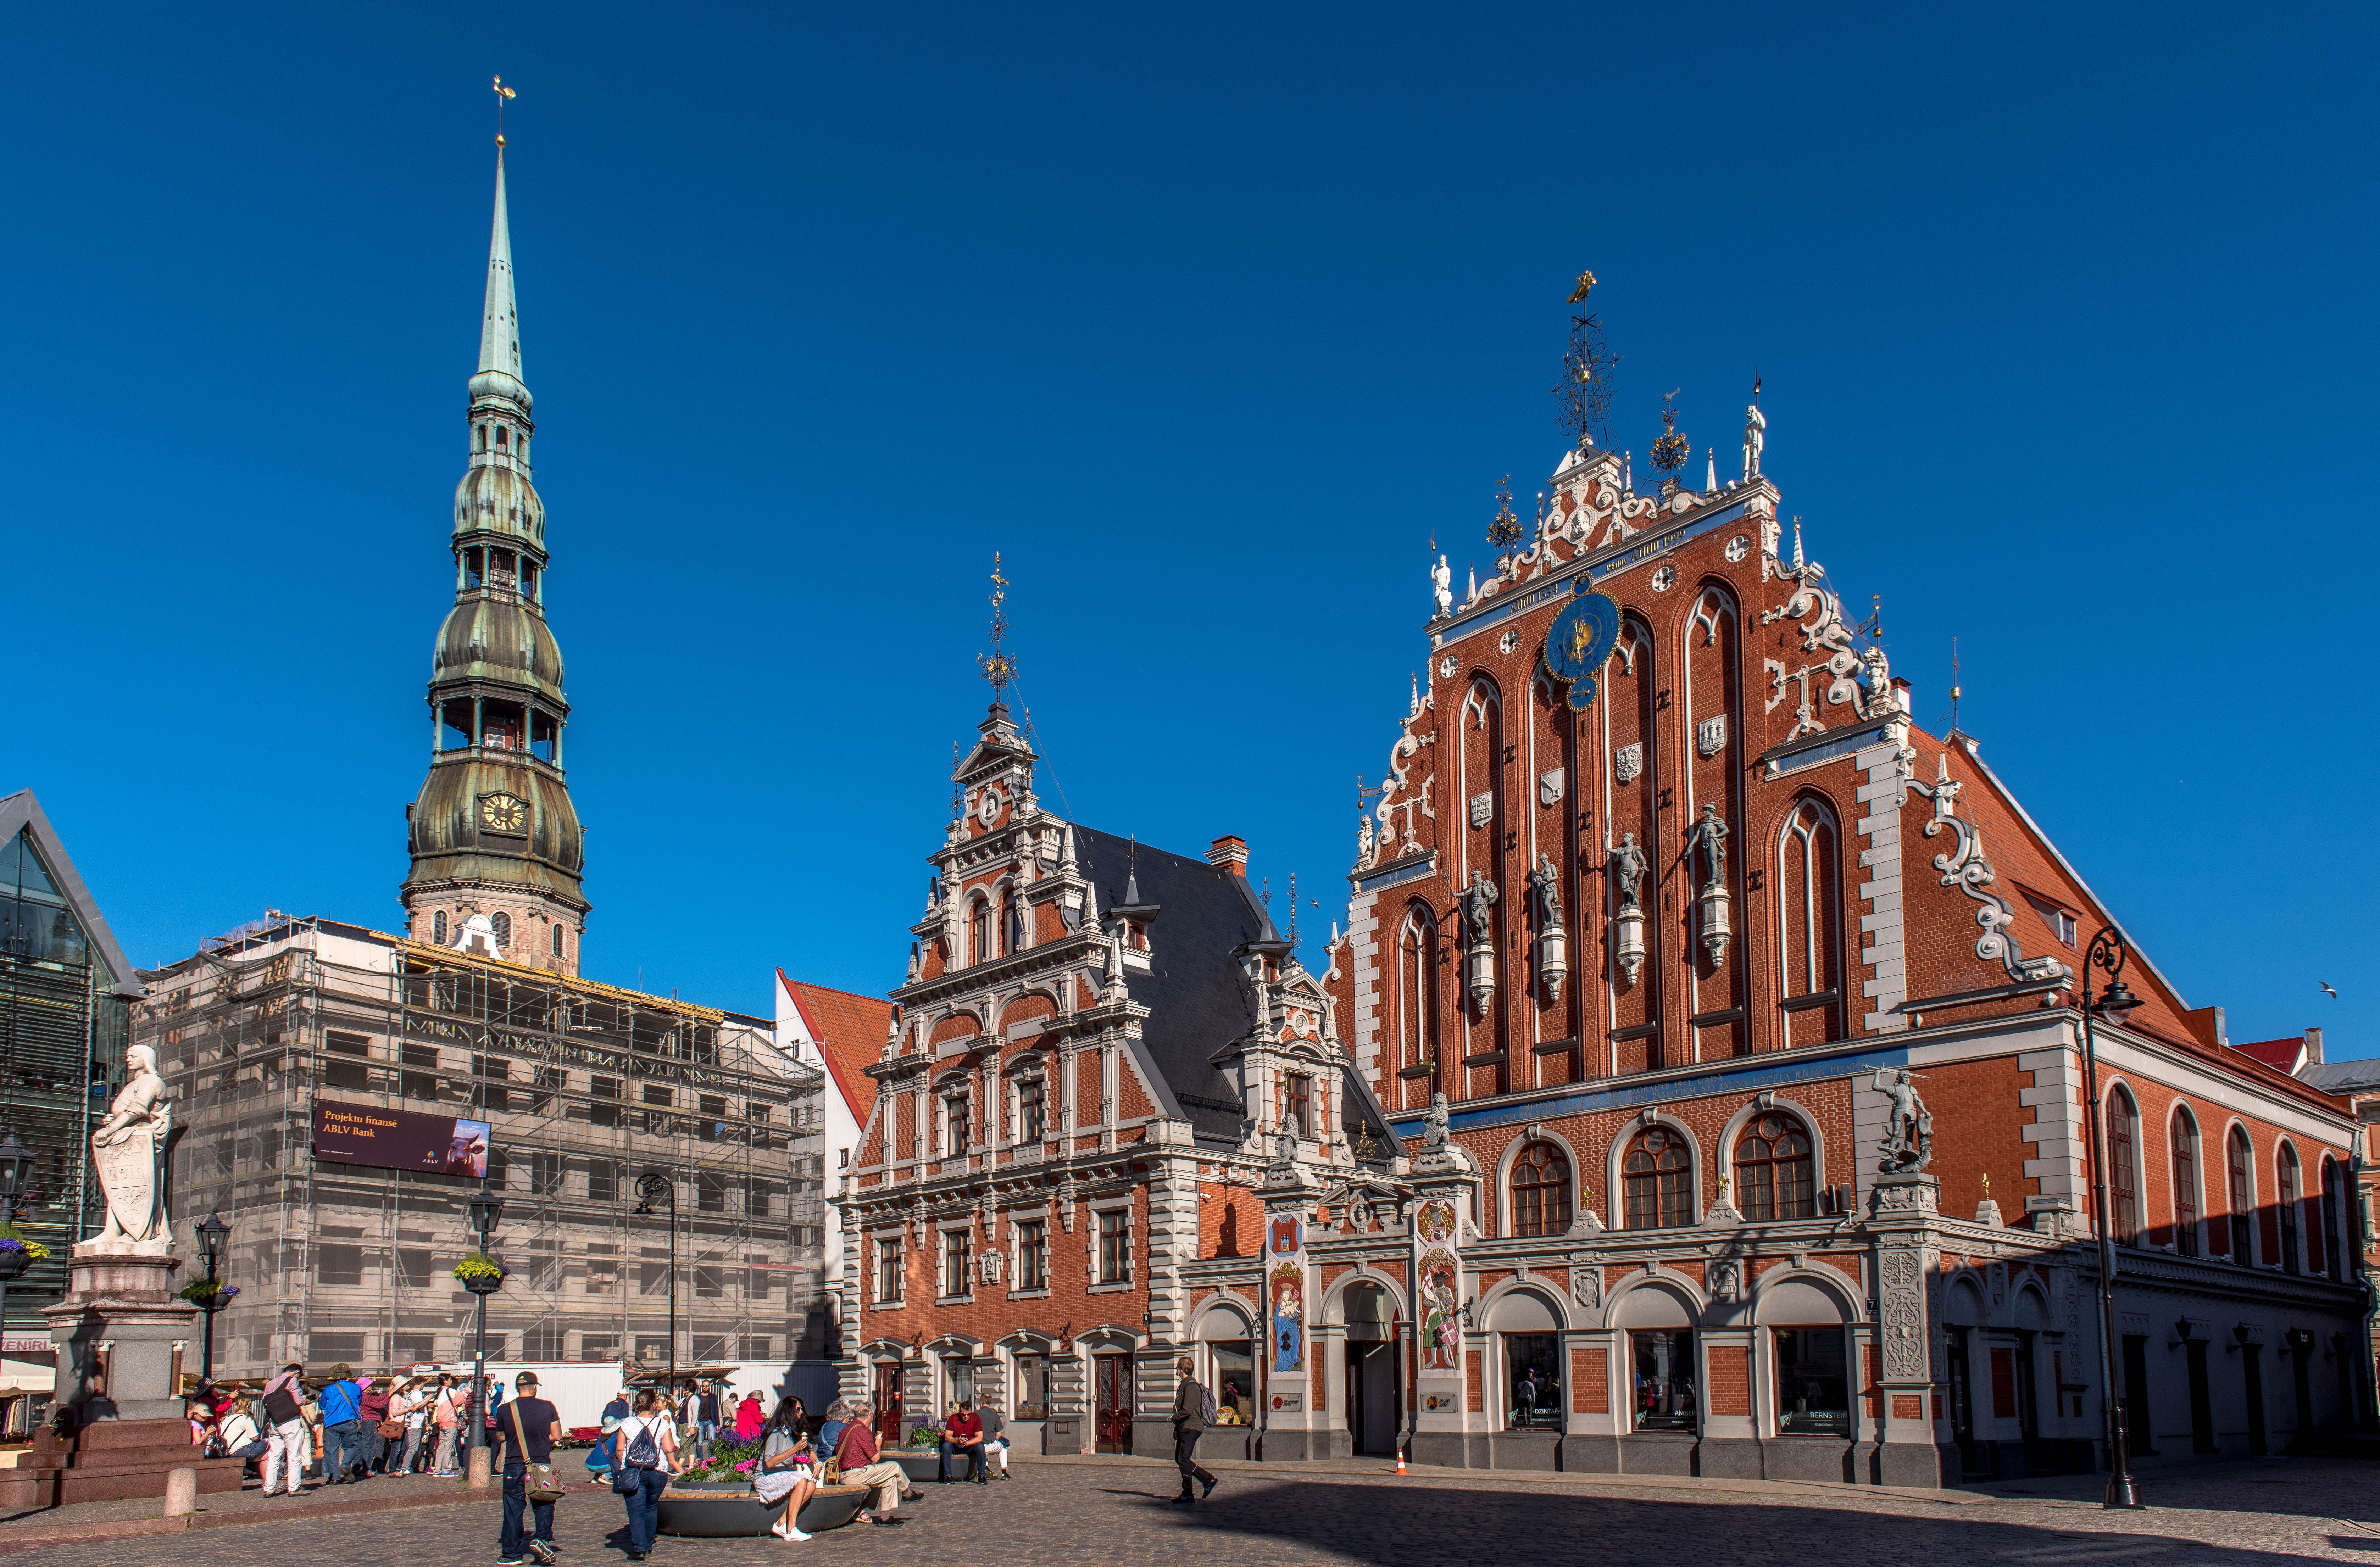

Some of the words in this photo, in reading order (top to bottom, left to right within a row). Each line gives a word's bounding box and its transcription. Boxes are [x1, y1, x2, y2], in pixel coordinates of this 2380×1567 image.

[1662, 529, 1686, 549] 1999
[1537, 583, 1558, 602] 1334
[1796, 757, 1810, 765] GOTTES
[1832, 745, 1846, 755] FLUCH
[1536, 1107, 1559, 1116] GODU
[1563, 1102, 1587, 1112] NAMU
[1607, 1094, 1647, 1105] VECAJIEM
[1652, 1087, 1696, 1099] PAMATIEM
[1700, 1084, 1714, 1092] NO
[1720, 1080, 1748, 1090] JAUNA
[1795, 1068, 1825, 1079] RĪGAS
[1578, 1093, 1599, 1102] NAMS
[1603, 1090, 1623, 1098] TIKA
[1628, 1083, 1669, 1095] SAGRAUTS
[1674, 1080, 1693, 1088] 1941.
[1697, 1074, 1725, 1084] GADĀ.
[324, 1110, 363, 1123] Projektu
[365, 1115, 397, 1127] finansē
[323, 1123, 351, 1134] ABLV
[352, 1127, 376, 1137] Bank
